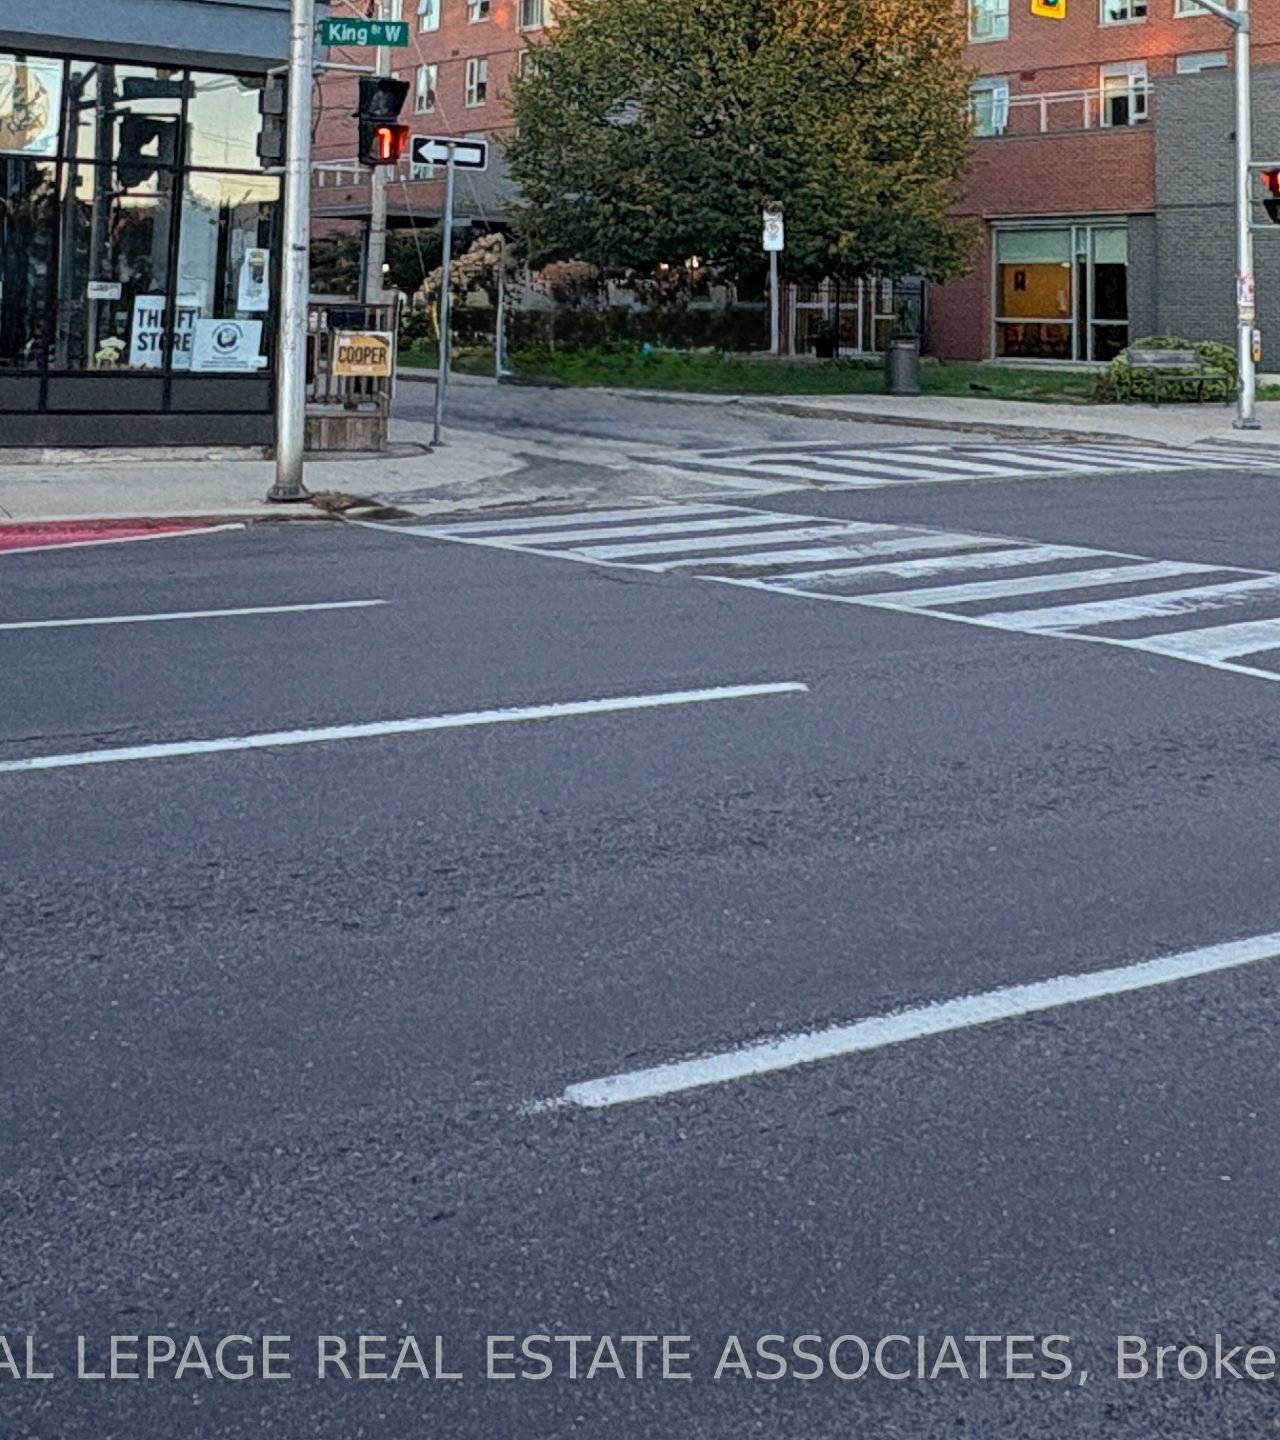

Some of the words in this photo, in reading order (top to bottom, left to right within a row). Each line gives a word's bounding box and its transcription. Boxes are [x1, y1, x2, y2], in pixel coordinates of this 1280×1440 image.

[328, 23, 368, 46] King
[384, 25, 401, 42] W
[137, 308, 196, 329] THFT
[337, 346, 387, 365] COOPER
